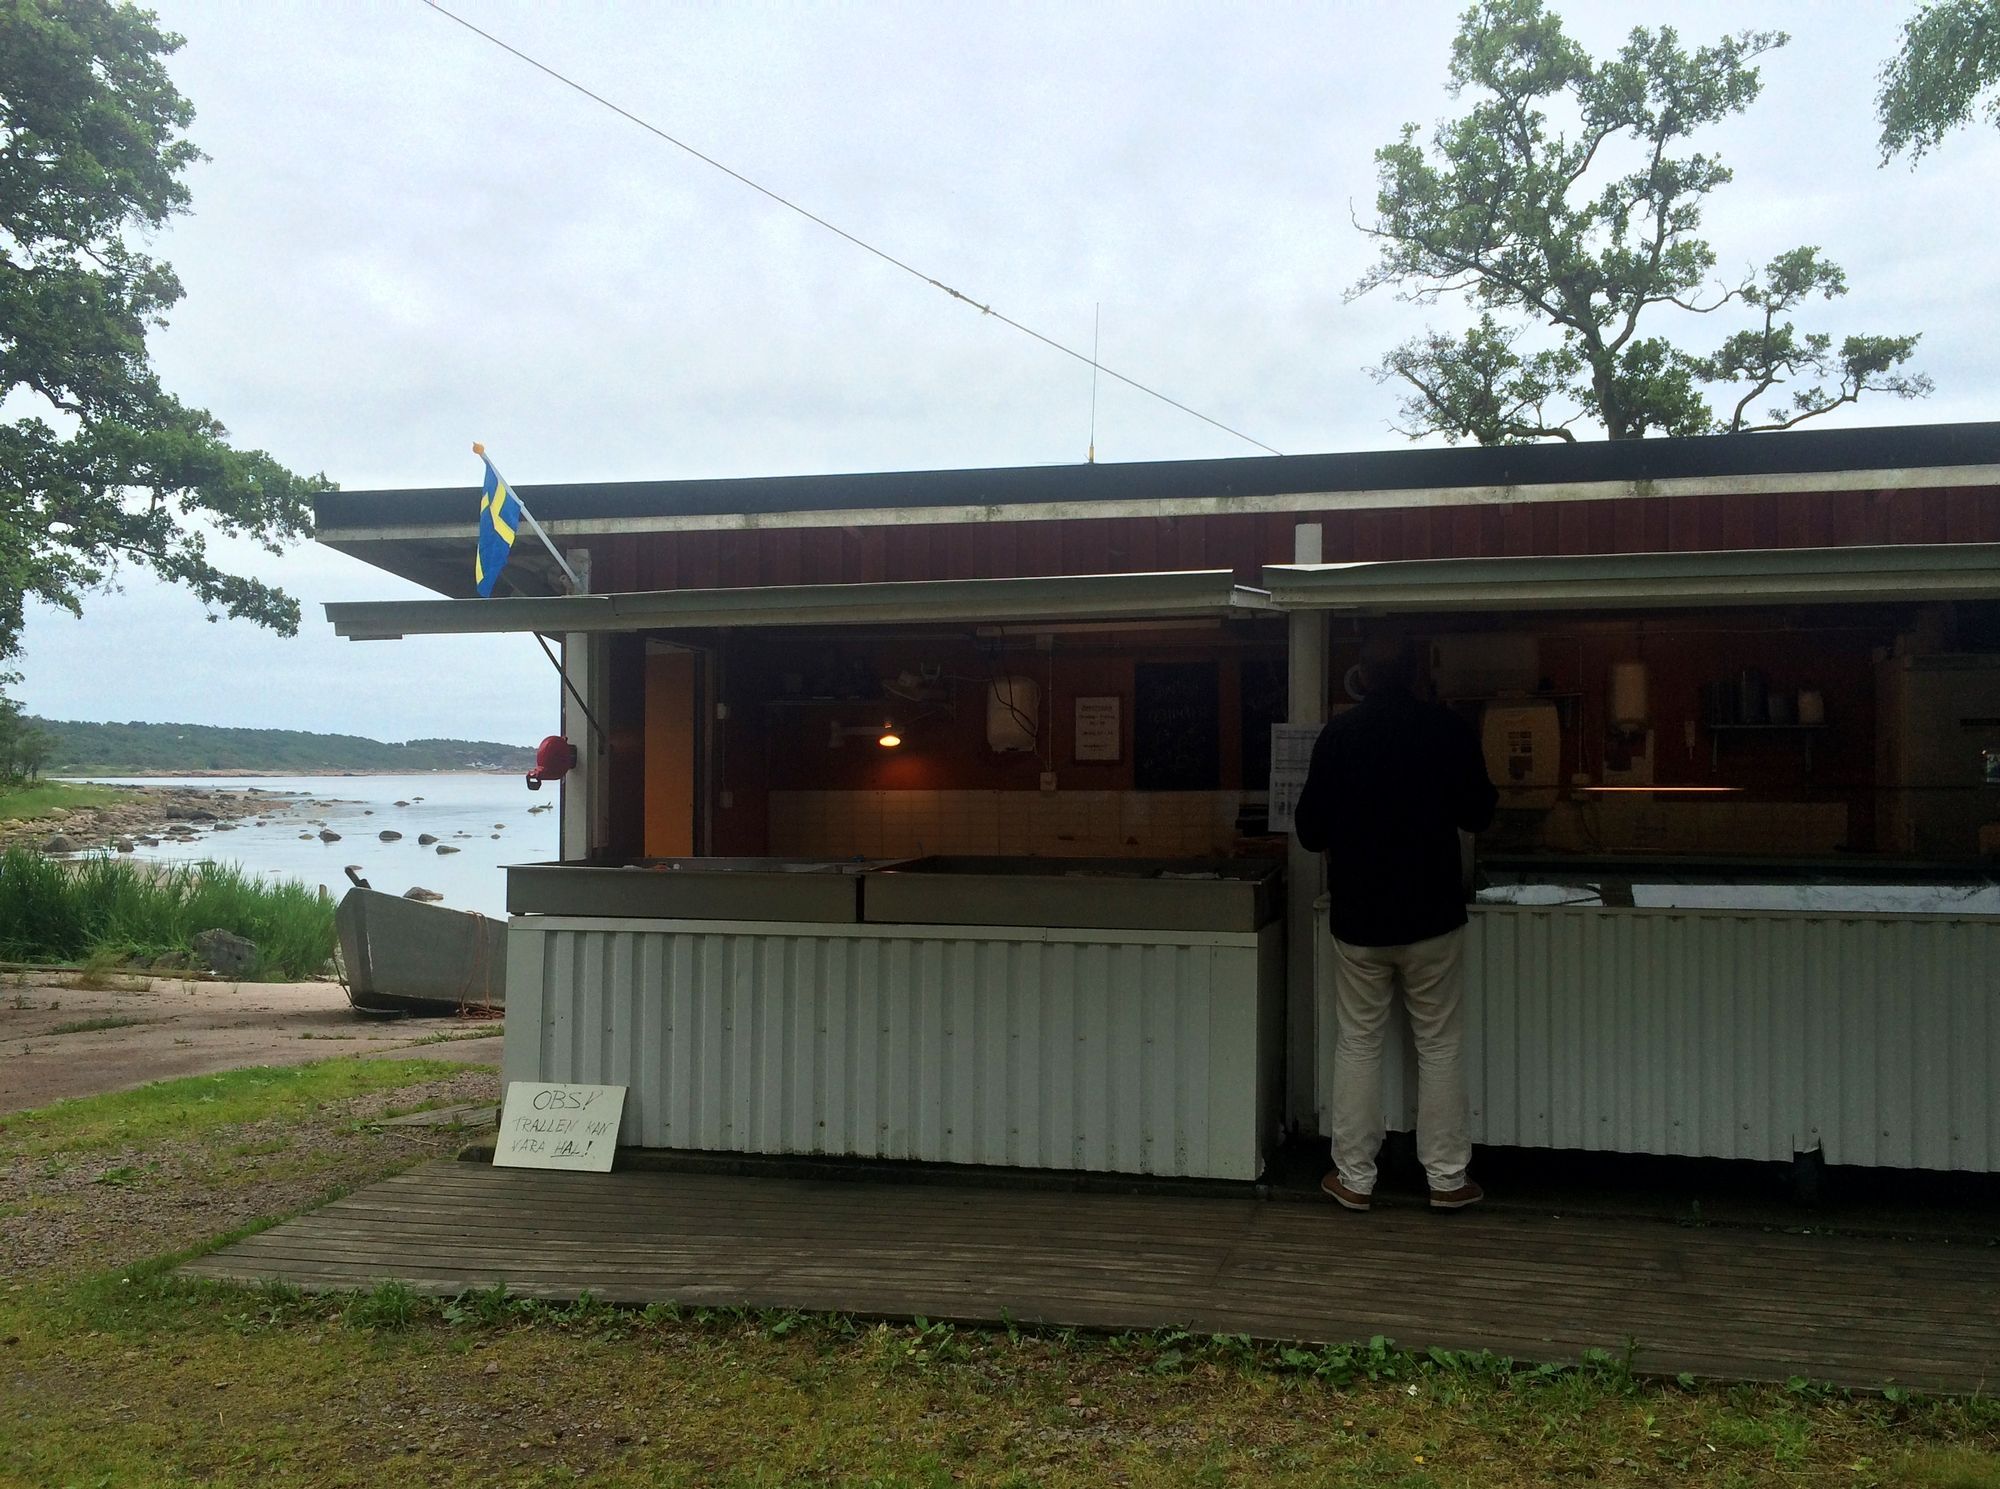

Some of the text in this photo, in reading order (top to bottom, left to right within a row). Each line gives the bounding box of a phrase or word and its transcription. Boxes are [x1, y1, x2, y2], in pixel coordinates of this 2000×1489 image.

[533, 1090, 603, 1110] OBS!
[512, 1116, 615, 1136] TRALLEN KAN
[511, 1138, 546, 1153] VARA
